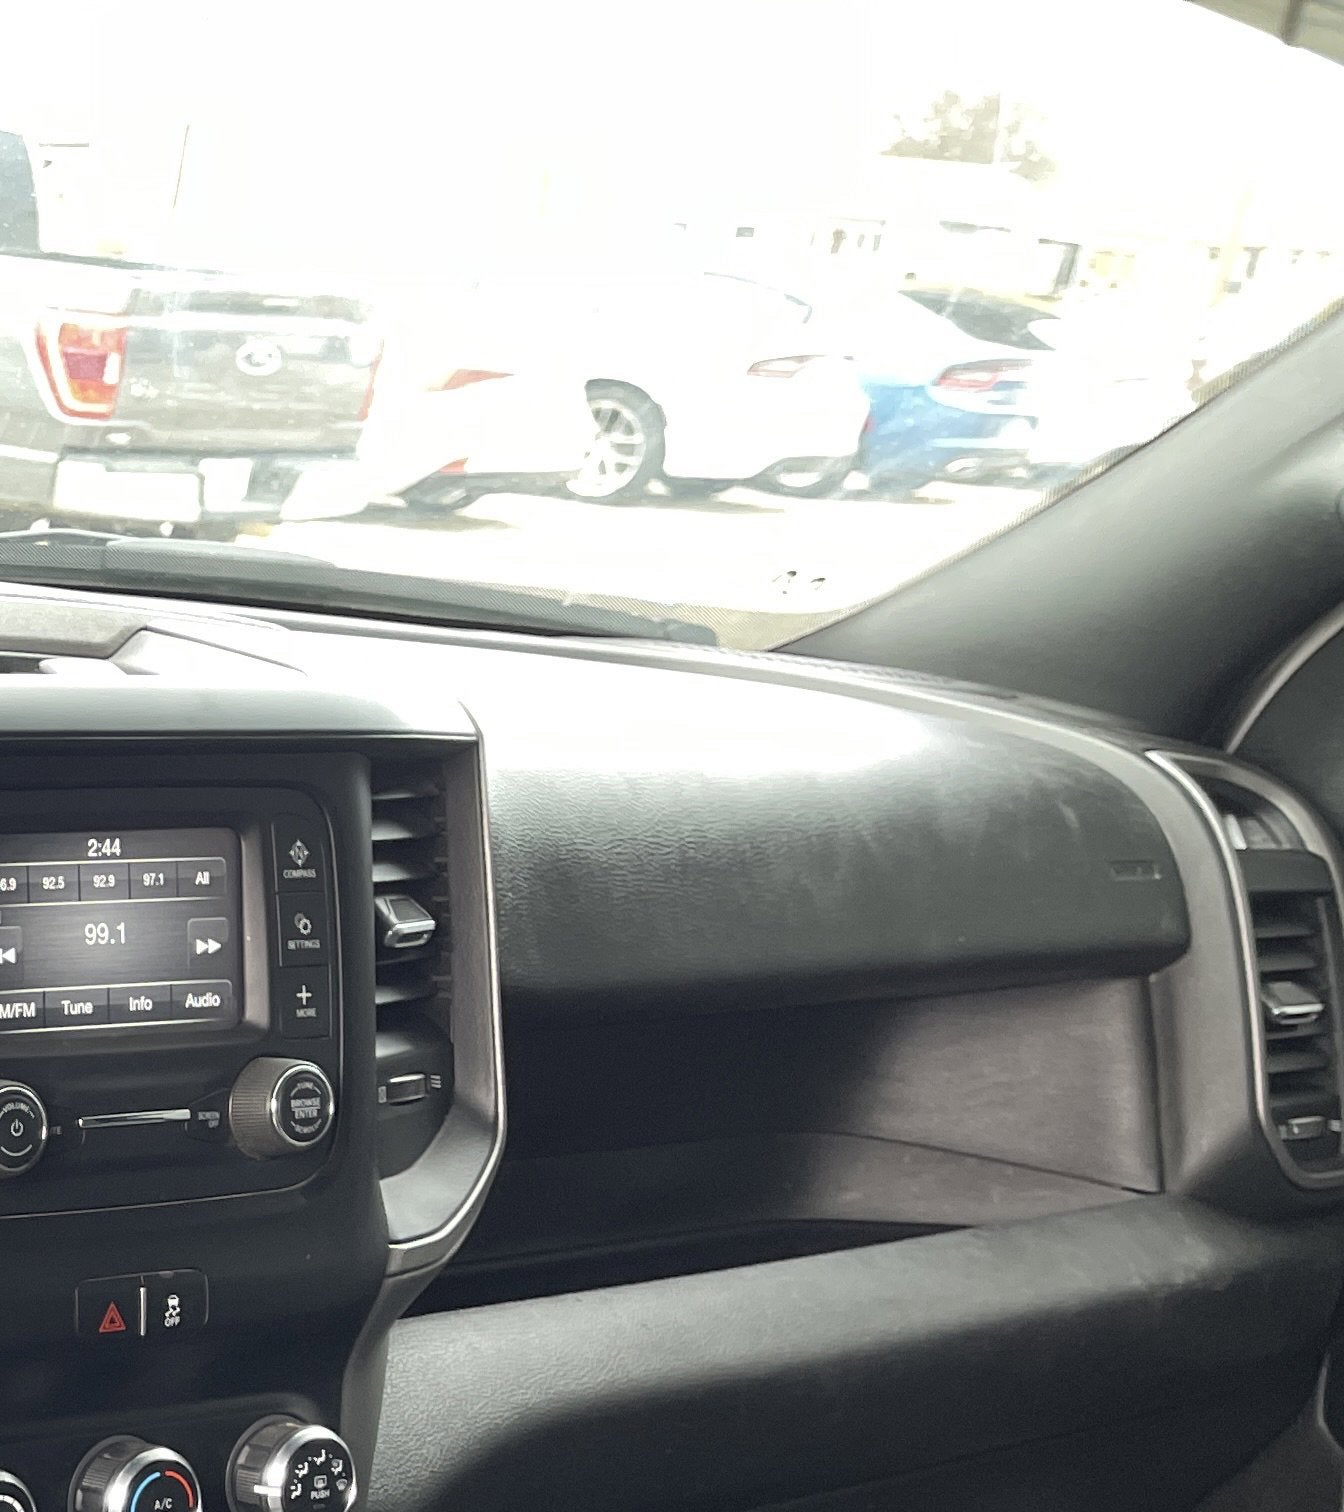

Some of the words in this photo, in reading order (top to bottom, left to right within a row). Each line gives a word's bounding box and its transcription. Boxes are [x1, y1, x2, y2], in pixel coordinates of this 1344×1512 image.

[87, 838, 121, 857] 2:44
[142, 873, 165, 887] 97.1
[195, 870, 210, 885] All
[283, 868, 317, 879] COMPASS
[84, 922, 127, 945] 99.1
[287, 939, 321, 950] SETTINGS
[61, 1000, 93, 1015] Tune
[128, 996, 153, 1012] Info
[185, 993, 221, 1008] Audio
[296, 1007, 317, 1018] MORE
[295, 1108, 318, 1119] ENTER
[164, 1316, 181, 1328] OFF
[310, 1488, 331, 1500] PUSH
[154, 1499, 172, 1511] A/C
